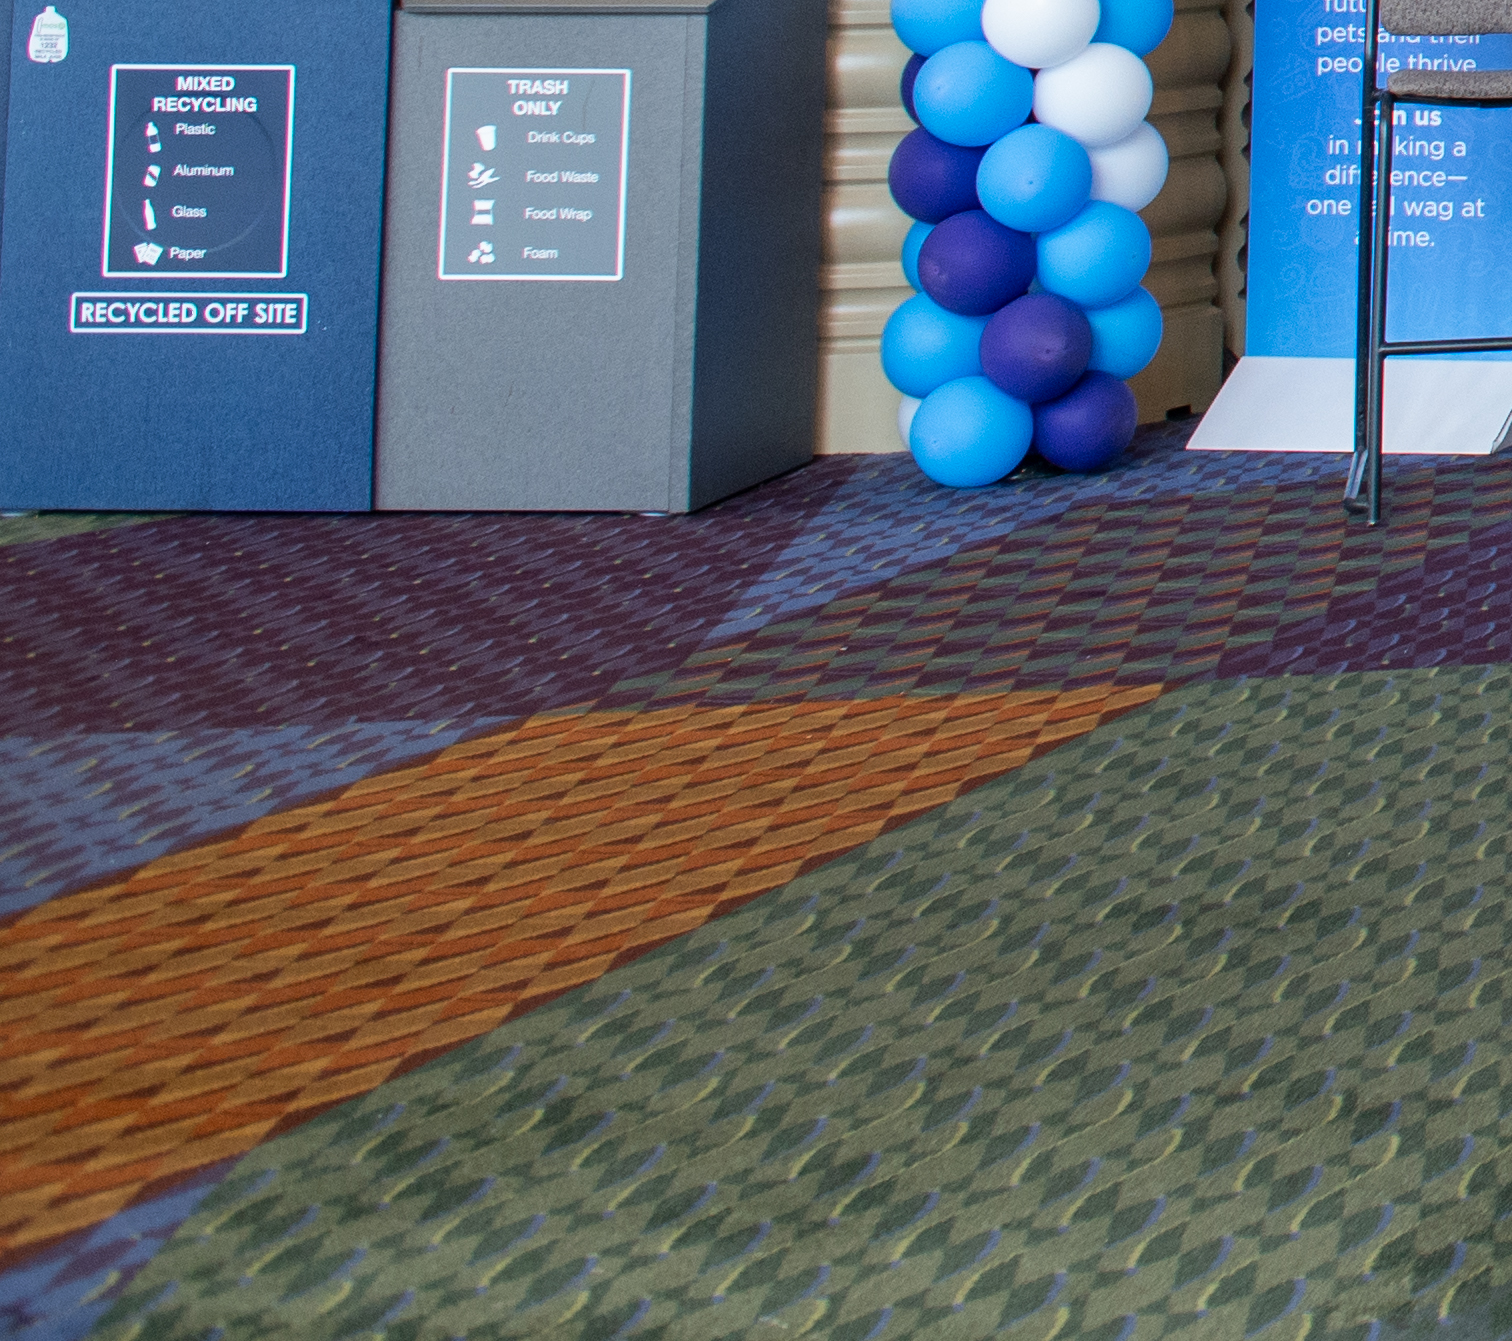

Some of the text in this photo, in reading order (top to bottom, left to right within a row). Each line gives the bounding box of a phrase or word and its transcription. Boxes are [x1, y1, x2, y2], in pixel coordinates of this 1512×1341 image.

[1316, 54, 1401, 76] peole
[176, 76, 235, 91] MIXED
[507, 79, 570, 95] TRASH
[152, 97, 258, 113] RECYCLING
[512, 100, 563, 116] ONLY
[1415, 110, 1442, 126] us
[175, 123, 216, 136] Plastic
[527, 130, 596, 146] Drink Cups
[1328, 134, 1349, 155] in
[1453, 141, 1467, 157] a
[173, 164, 234, 176] Aluminum
[525, 170, 600, 183] Food Waste
[172, 205, 207, 218] Glass
[523, 207, 593, 222] Food Wrap
[1307, 199, 1352, 216] one
[1403, 200, 1454, 221] wag
[1461, 198, 1486, 218] at
[1388, 226, 1435, 247] ime.
[169, 247, 207, 262] Paper
[522, 247, 559, 259] Foam
[80, 302, 298, 324] RECYCLED OFF SITE
